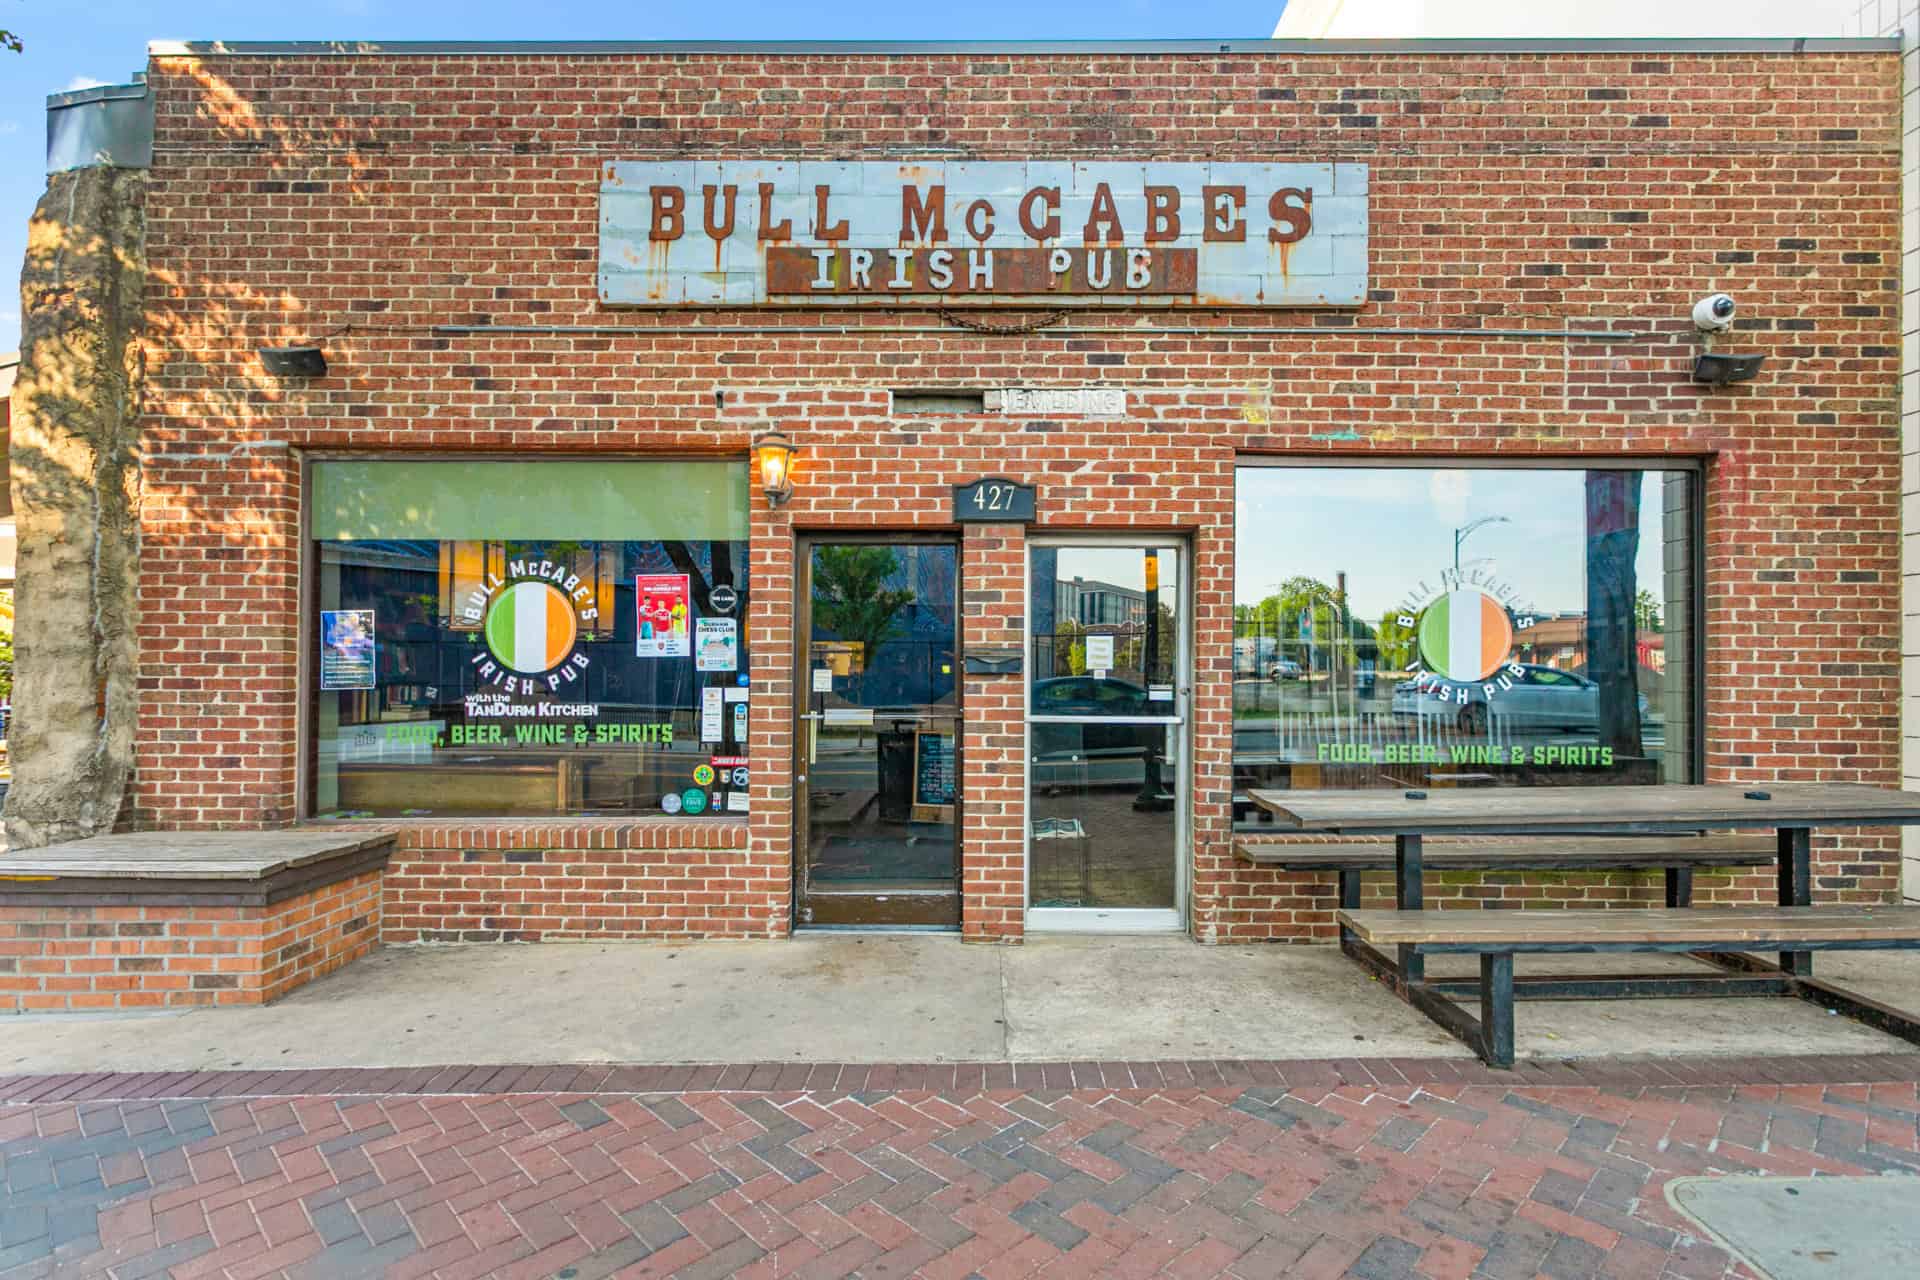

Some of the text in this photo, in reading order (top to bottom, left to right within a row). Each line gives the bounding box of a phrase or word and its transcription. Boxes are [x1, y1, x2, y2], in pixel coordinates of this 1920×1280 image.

[648, 183, 849, 241] BULL
[811, 248, 1152, 290] IRISH PUB
[973, 485, 1016, 510] 427
[464, 559, 599, 621] BULL McCABE'S
[471, 652, 590, 695] IRISH PUB
[1405, 660, 1526, 704] IRISH PUB
[465, 694, 511, 702] with the
[537, 702, 599, 716] KITCHEN
[384, 725, 445, 747] FOOD,
[451, 725, 508, 746] BEER,
[514, 724, 567, 744] WINE
[573, 724, 589, 744] &
[595, 723, 673, 743] SPIRITS
[1317, 743, 1614, 766] FOOD, BEER, WINE & SPIRITS
